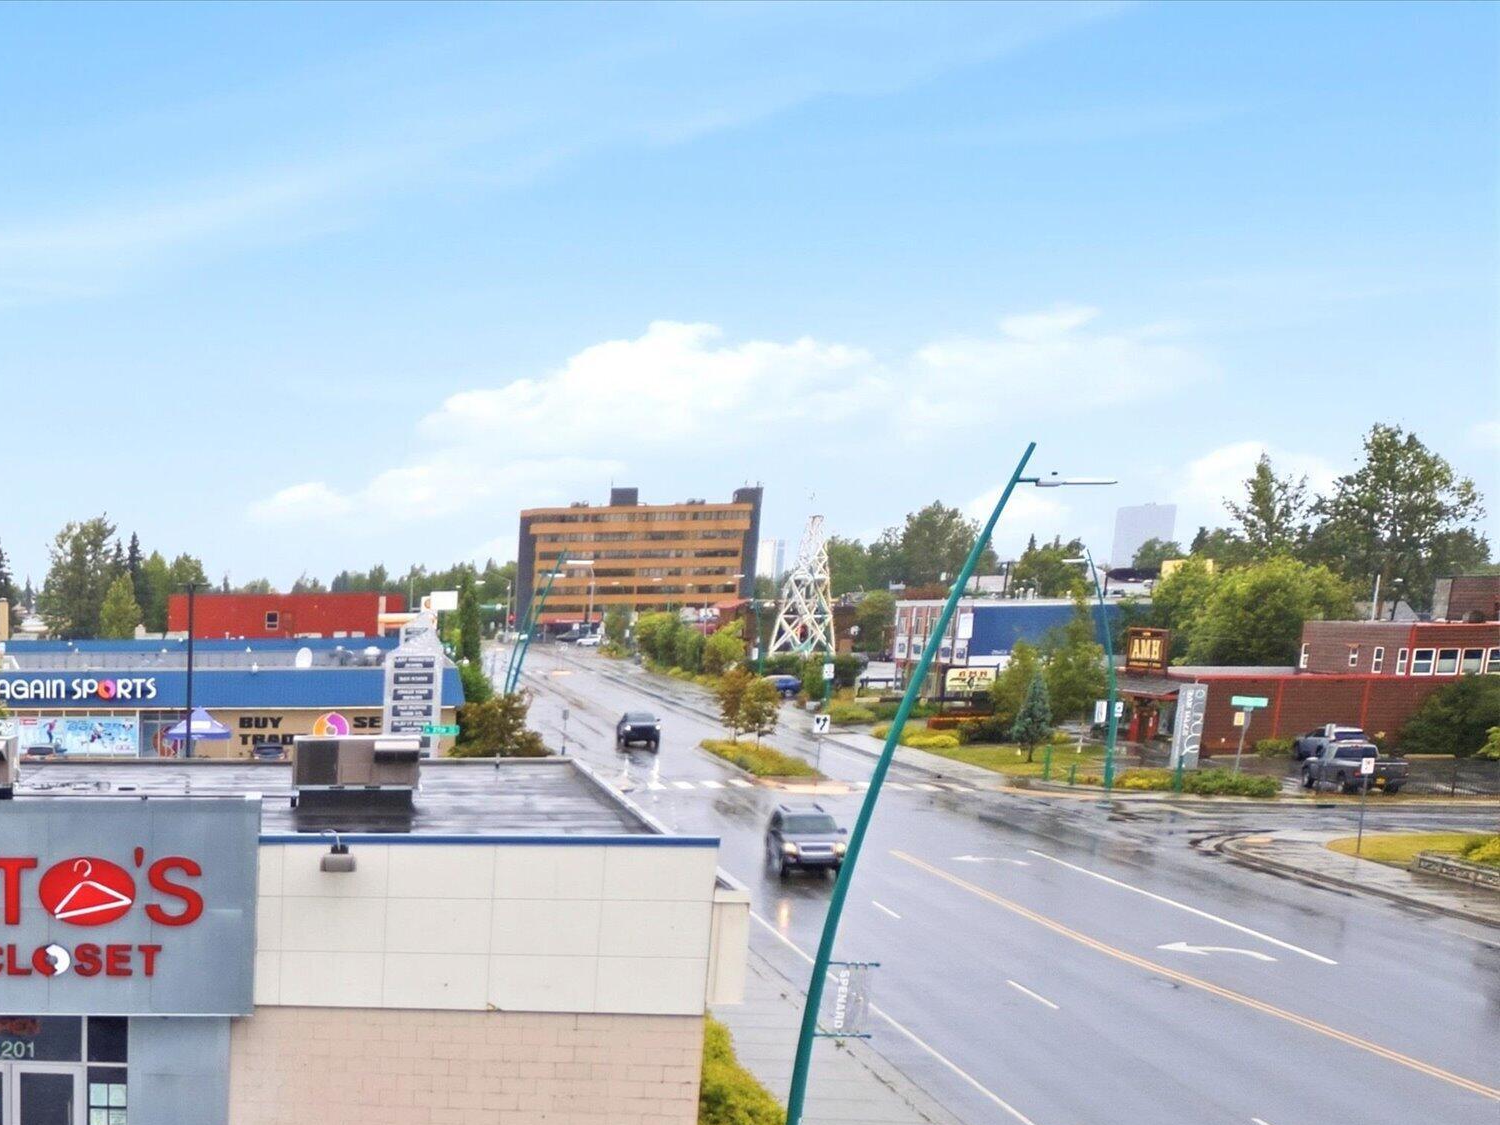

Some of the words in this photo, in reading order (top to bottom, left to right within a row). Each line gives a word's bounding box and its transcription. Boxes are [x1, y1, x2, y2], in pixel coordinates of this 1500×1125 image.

[71, 677, 157, 700] SPORTS
[239, 716, 283, 729] BUY
[239, 734, 307, 746] TRAD
[833, 969, 851, 1030] SPENARD
